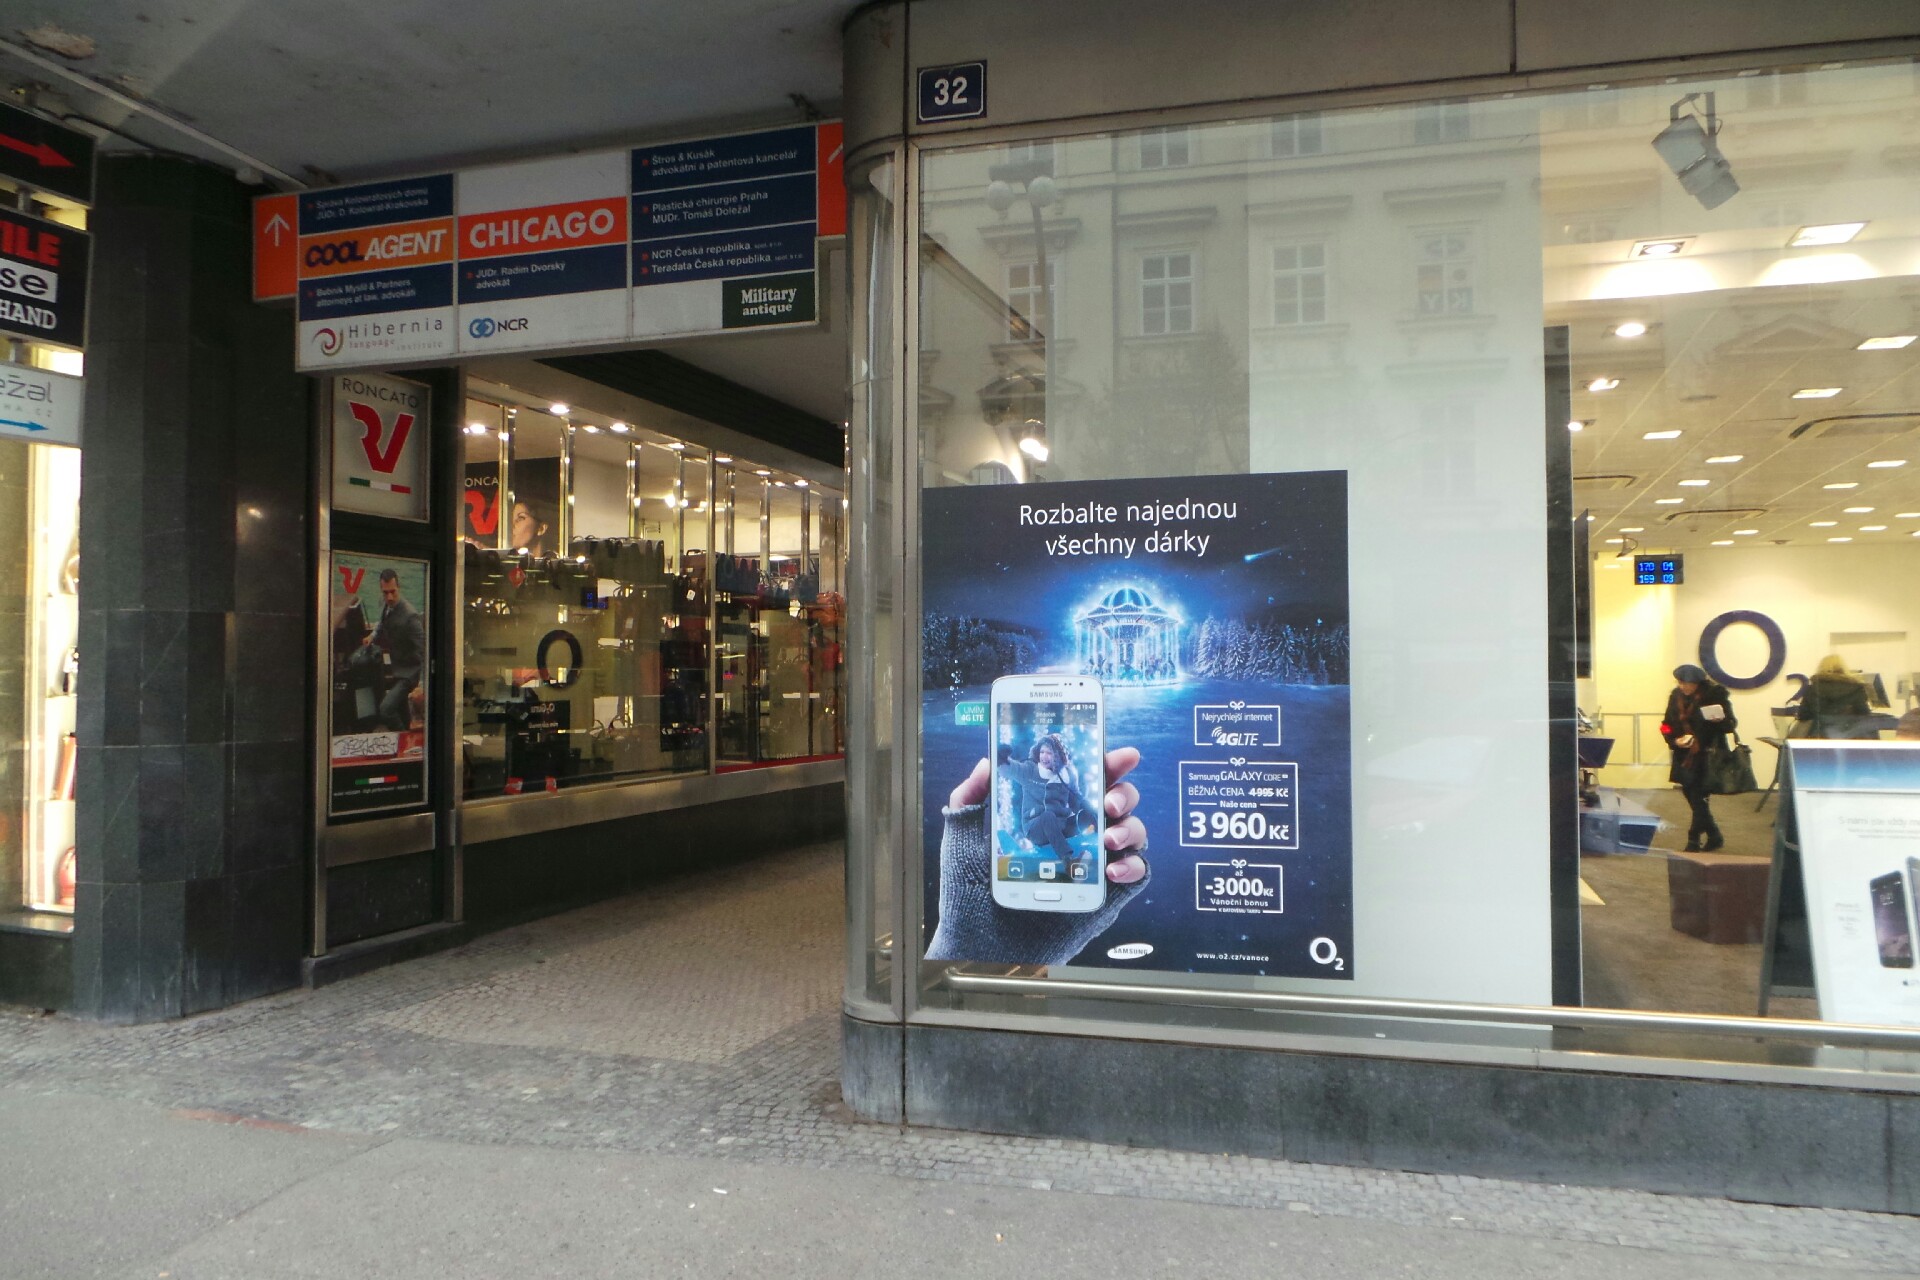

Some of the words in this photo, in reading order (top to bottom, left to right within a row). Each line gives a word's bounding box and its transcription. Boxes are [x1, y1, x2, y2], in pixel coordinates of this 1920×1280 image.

[934, 76, 968, 106] 32
[678, 152, 685, 162] &
[686, 149, 715, 161] Kusák
[699, 163, 705, 171] a
[707, 156, 754, 171] patentová
[652, 199, 694, 213] Plastická
[696, 195, 738, 208] chirurgie
[740, 190, 769, 202] Praha
[652, 212, 681, 225] MUDr.
[683, 207, 713, 221] Tomáš
[716, 204, 751, 217] Doležal
[469, 207, 615, 249] CHICAGO
[0, 220, 61, 267] ILE
[652, 248, 673, 260] NCR
[674, 245, 704, 258] Česká
[706, 241, 751, 256] republika
[476, 268, 498, 279] JUDr.
[501, 264, 529, 276] Radim
[652, 260, 692, 274] Teradata
[694, 255, 724, 270] Česká
[726, 253, 771, 268] republika
[476, 277, 511, 290] advokát
[741, 286, 797, 305] Military
[742, 301, 793, 317] antique
[349, 317, 443, 338] Hibernia
[497, 317, 529, 333] NCR
[342, 377, 420, 409] RONCATO
[1019, 500, 1118, 526] Rozbalte
[1126, 497, 1238, 527] najednou
[1045, 532, 1137, 559] všechny
[1144, 529, 1211, 558] dárky
[1029, 691, 1064, 699] SAMSUNG
[960, 714, 972, 722] 4G
[972, 714, 985, 722] LTE
[1201, 712, 1243, 724] Nejrychlejší
[1243, 712, 1274, 723] internet
[1188, 772, 1220, 783] Samsung
[1219, 770, 1263, 782] GALAXY
[1263, 773, 1282, 783] CORE
[1188, 785, 1218, 797] BĚŽNÁ
[1219, 787, 1246, 797] CENA
[1275, 787, 1289, 798] Kč
[1219, 800, 1239, 809] Naše
[1239, 801, 1258, 809] cena
[1268, 824, 1290, 841] Kč
[1234, 869, 1244, 877] až
[1210, 897, 1242, 907] Vánoční
[1243, 898, 1269, 908] bonus
[1113, 947, 1149, 956] SAMSUNG
[1196, 951, 1270, 963] www.o2.cz/vanoce
[1308, 936, 1345, 972] O2
